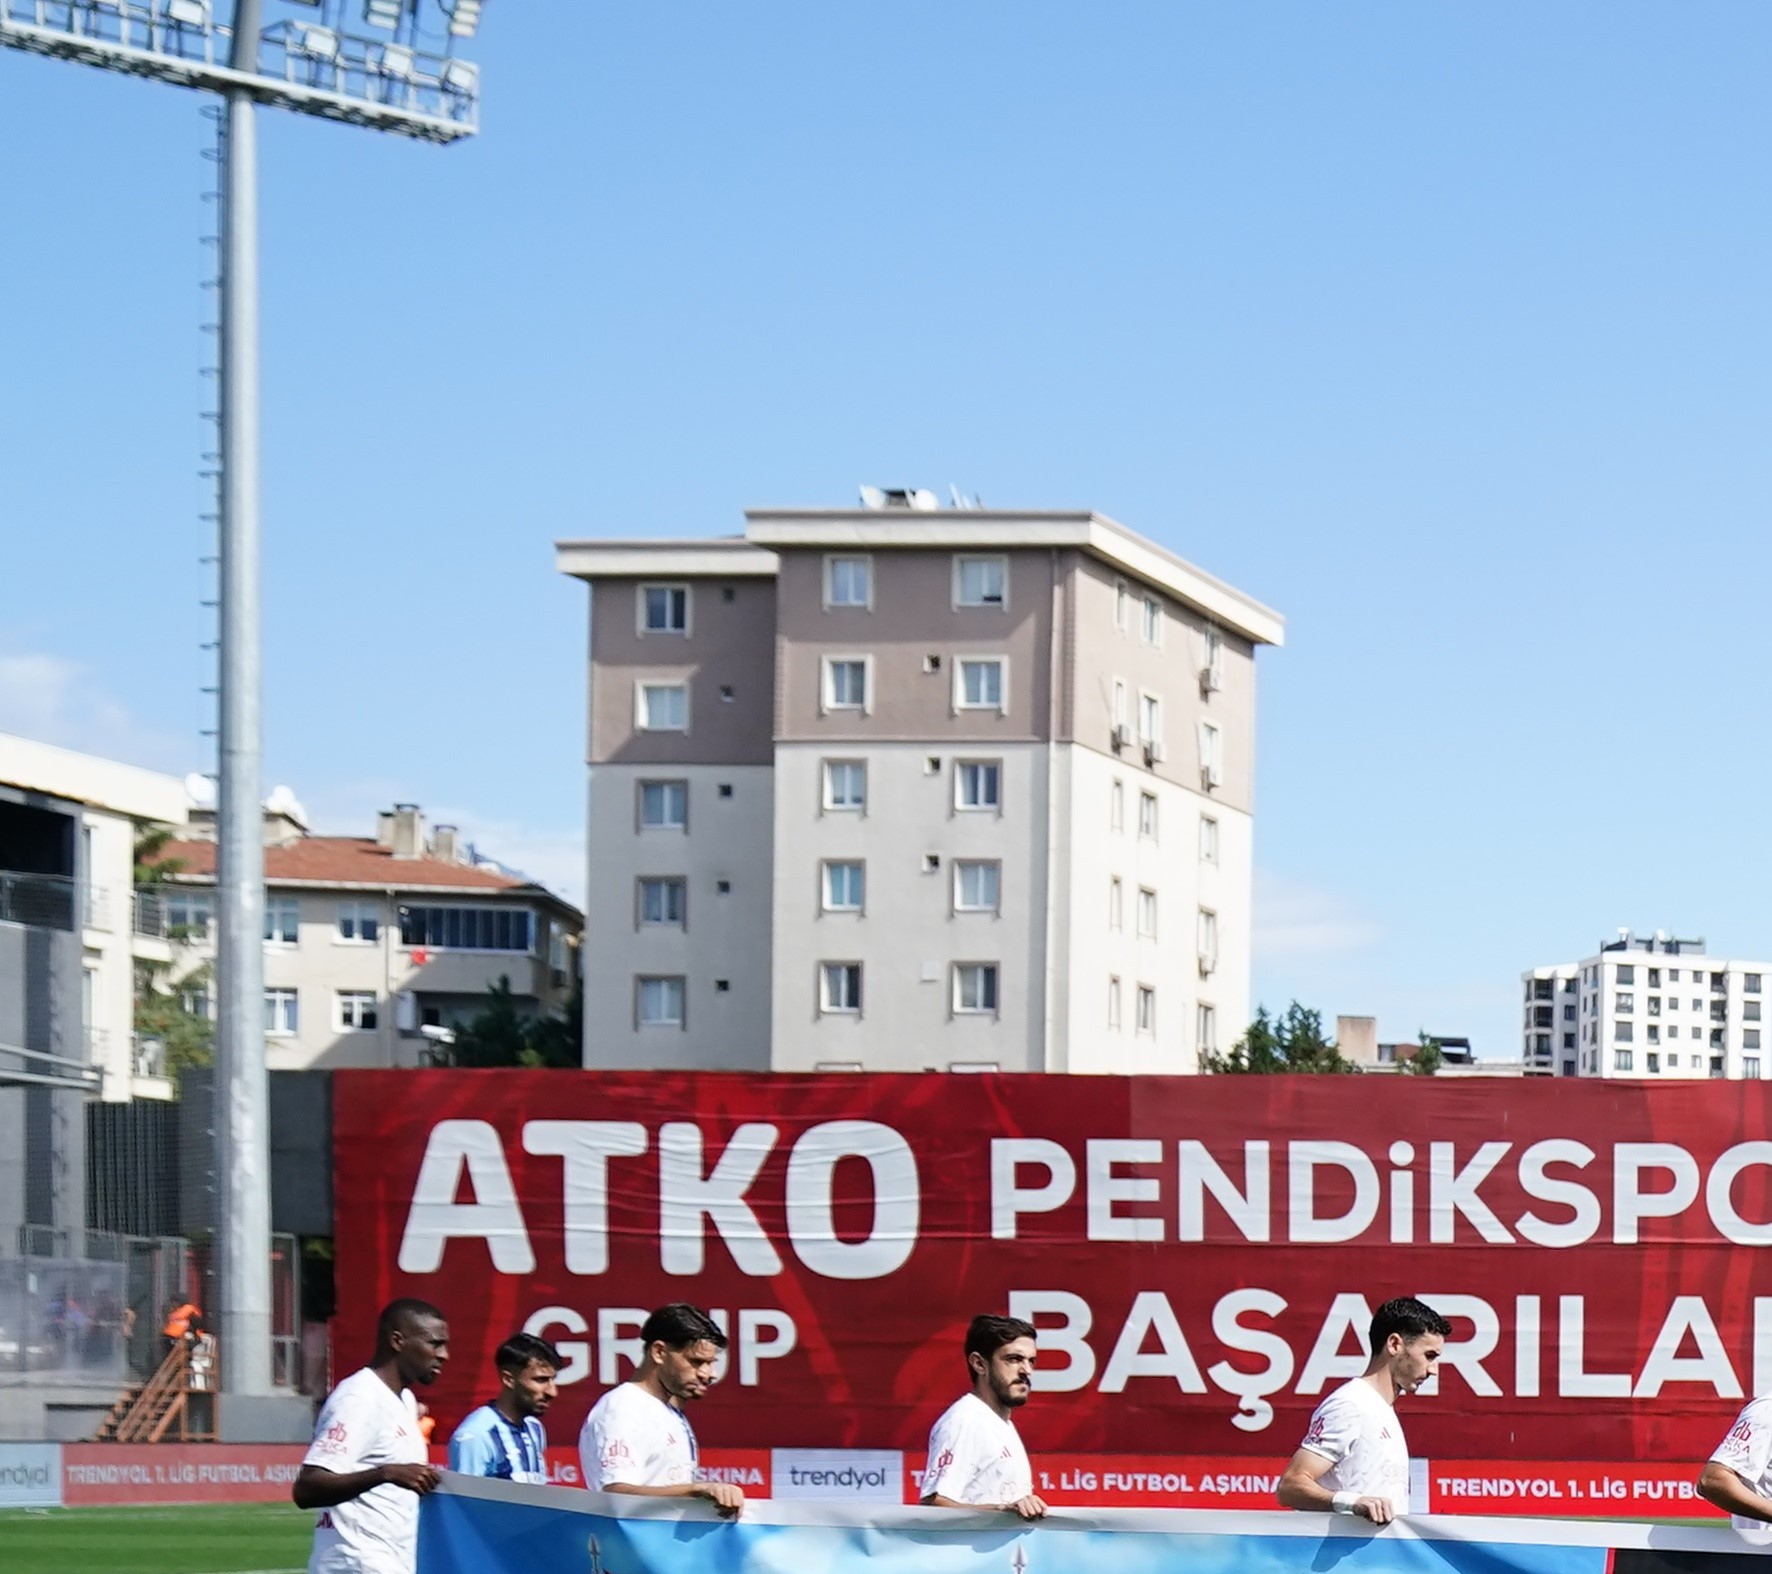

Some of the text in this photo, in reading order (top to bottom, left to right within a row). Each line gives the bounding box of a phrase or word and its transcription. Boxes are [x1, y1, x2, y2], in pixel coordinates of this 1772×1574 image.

[398, 1118, 921, 1281] ATKO
[790, 1465, 887, 1490] trendyol
[1061, 1468, 1098, 1492] LİG
[1102, 1472, 1194, 1493] FUTBOL
[1437, 1477, 1563, 1499] TRENDYOL
[1567, 1479, 1584, 1500] 1.
[1589, 1475, 1627, 1500] LİG
